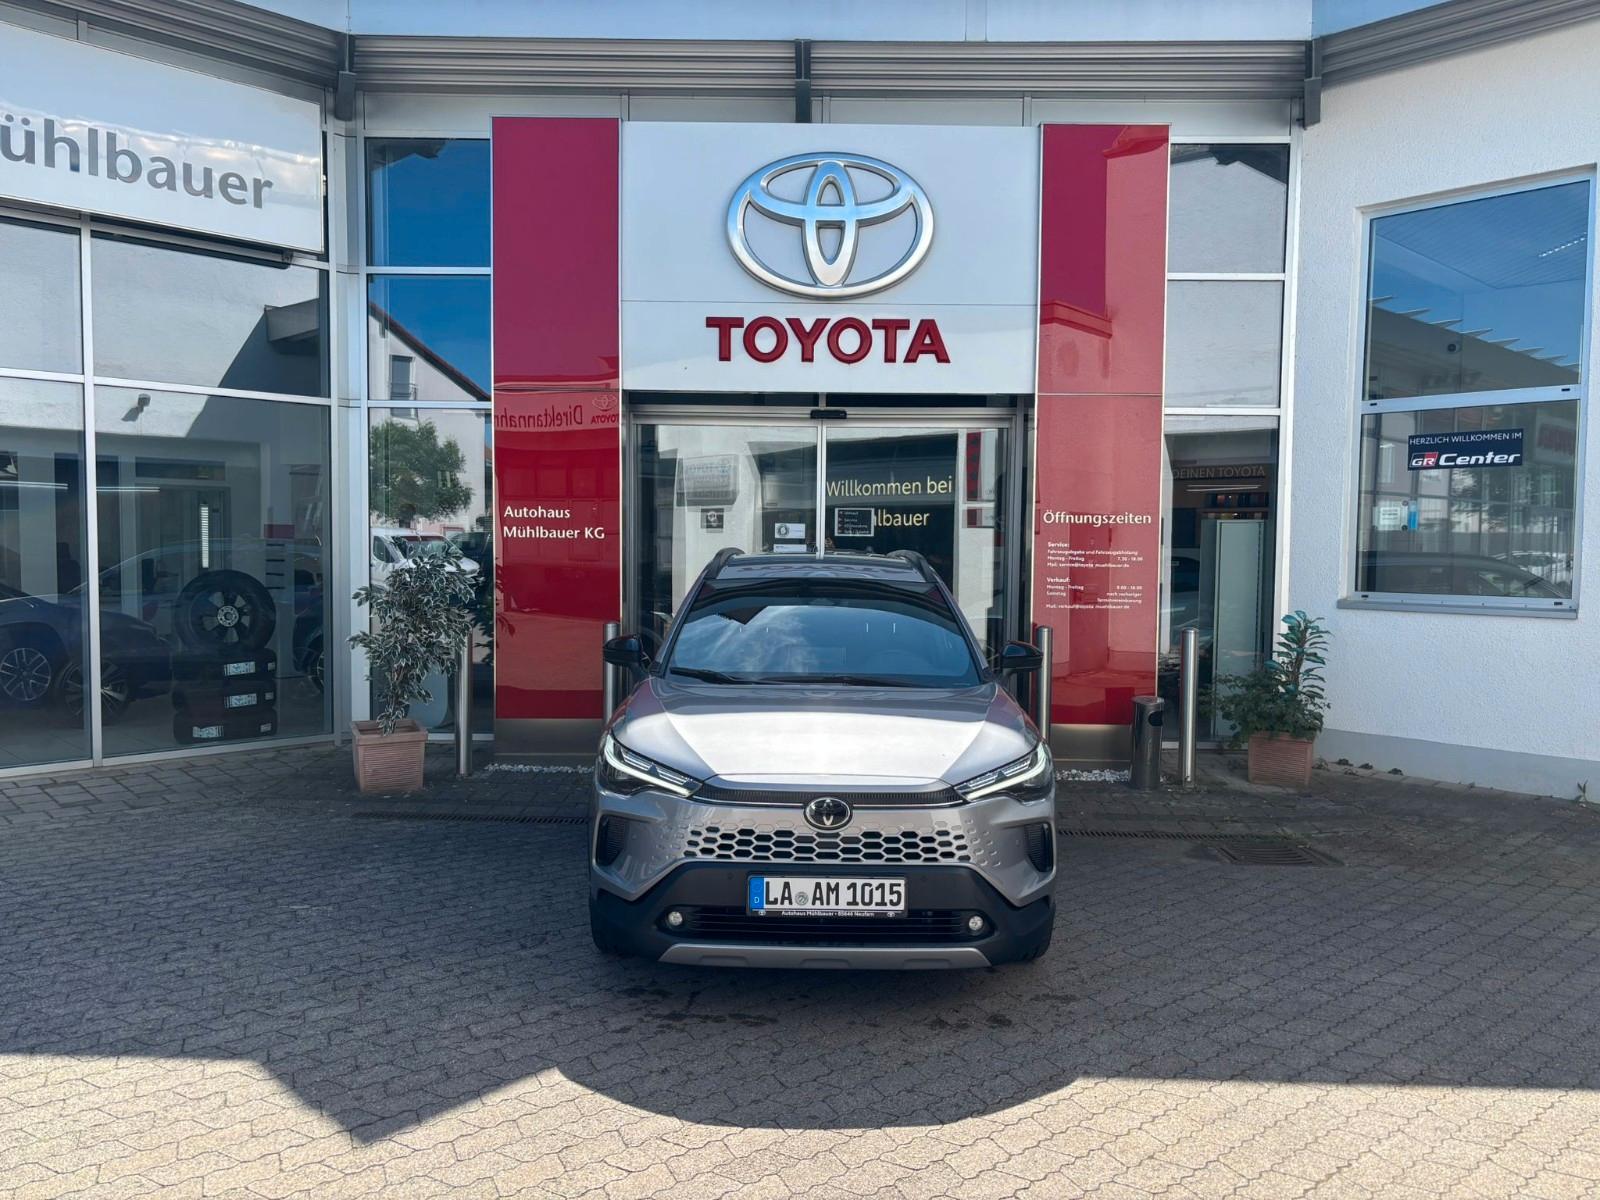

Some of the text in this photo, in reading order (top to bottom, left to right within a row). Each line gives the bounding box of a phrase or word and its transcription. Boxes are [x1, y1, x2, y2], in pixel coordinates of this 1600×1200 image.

[706, 316, 951, 364] TOYOTA
[1409, 432, 1522, 446] HERZLICH WILLKOMMEN IM
[1411, 450, 1521, 467] GR Center
[1217, 465, 1266, 478] TOYOTA
[826, 476, 952, 498] Willkommen bei
[503, 506, 571, 519] Autohaus
[873, 508, 930, 526] lbauer
[1043, 509, 1152, 527] Öffnungszeiten
[503, 525, 605, 539] Mühlbauer KG
[753, 896, 760, 904] D
[765, 881, 902, 907] LA AM 1015
